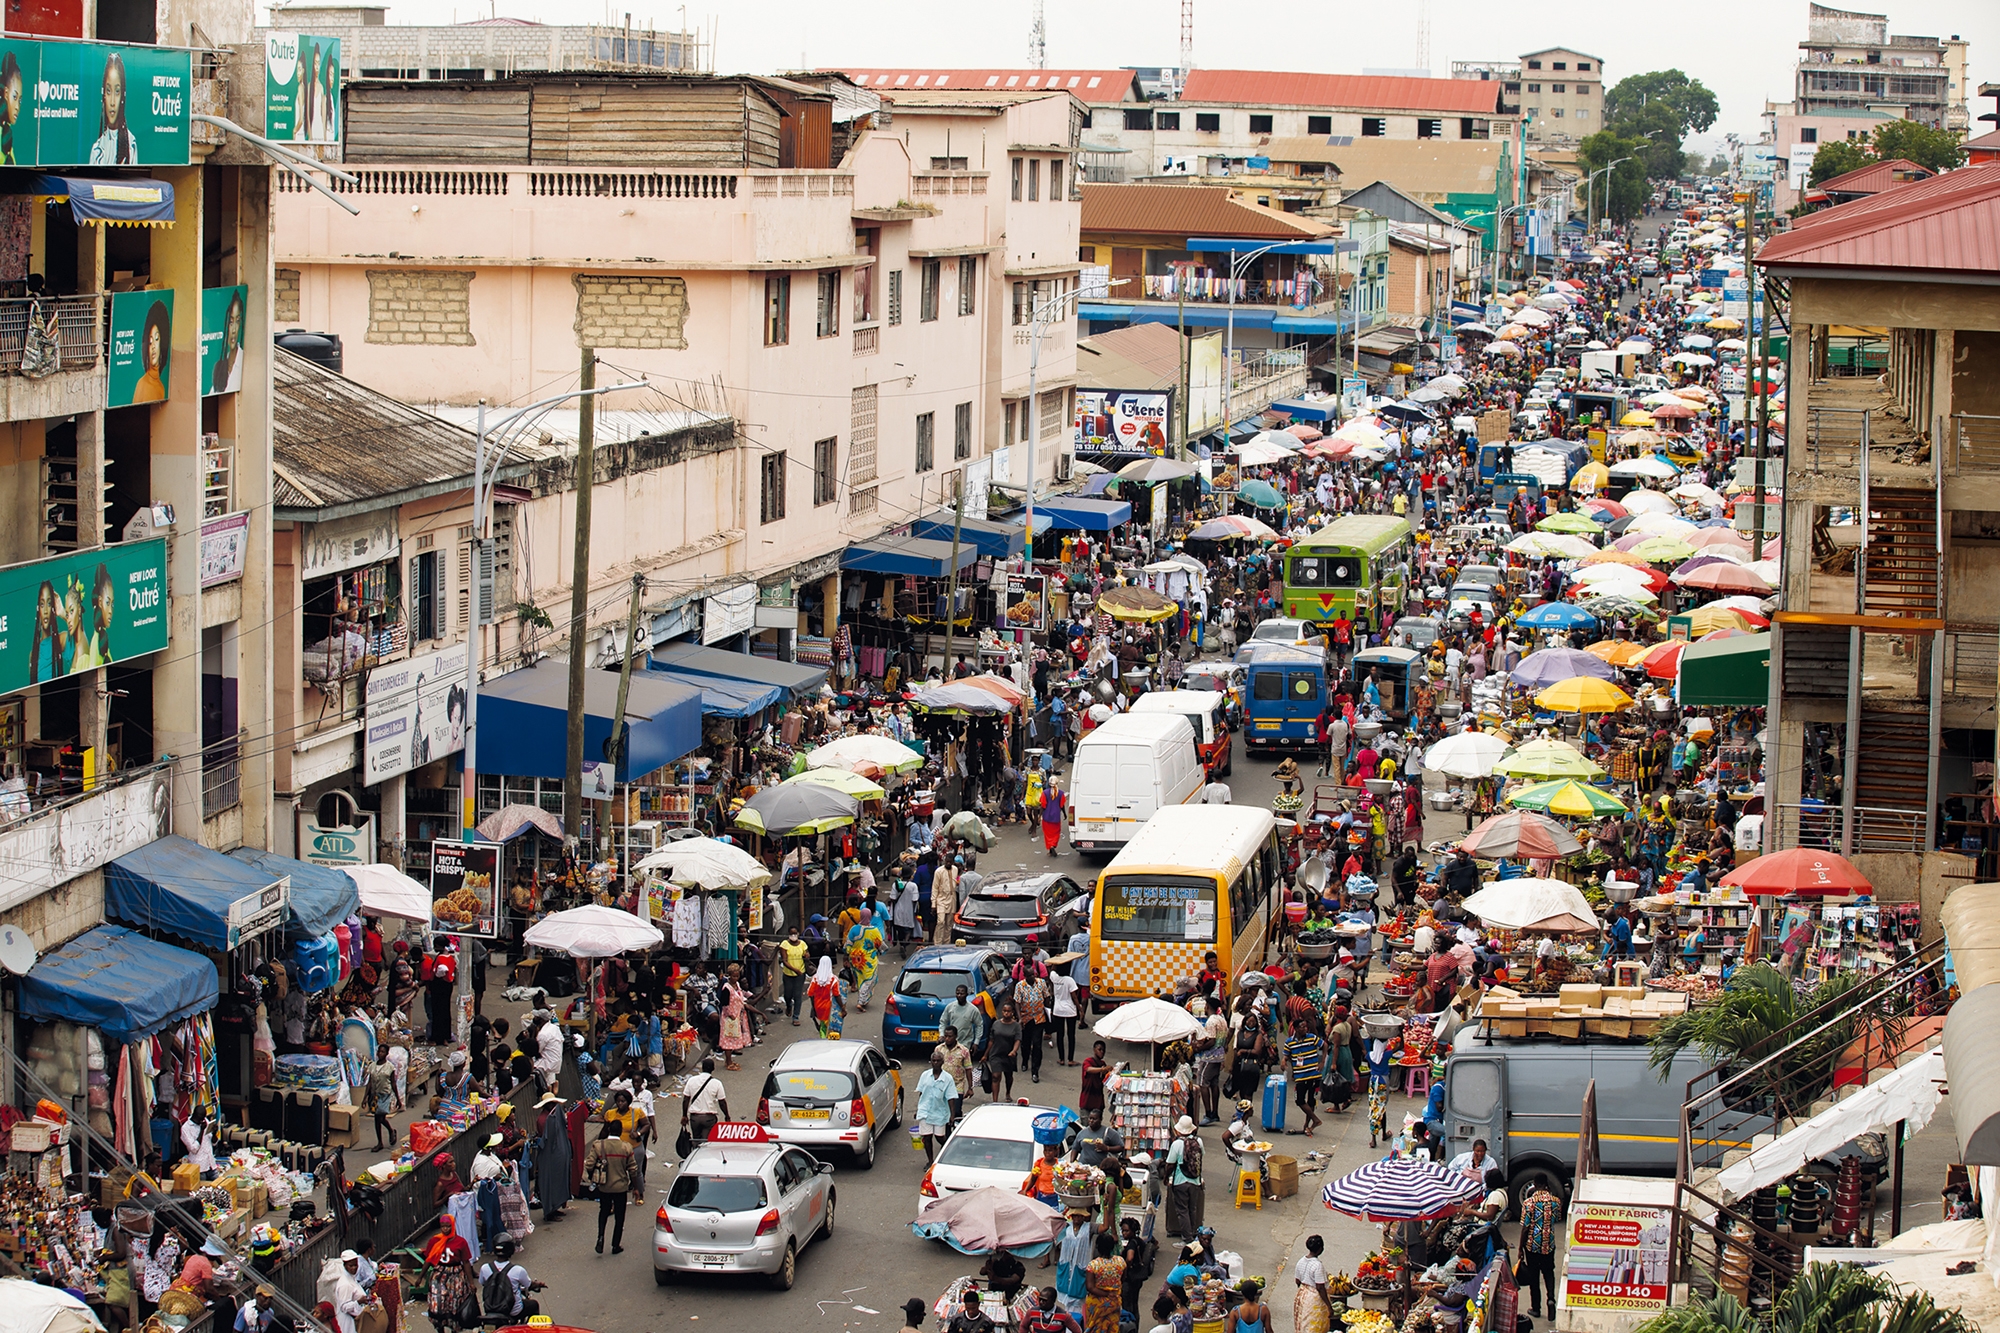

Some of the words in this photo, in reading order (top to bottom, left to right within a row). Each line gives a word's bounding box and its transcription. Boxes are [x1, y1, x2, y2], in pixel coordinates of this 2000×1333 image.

[271, 39, 295, 60] Outré
[153, 76, 166, 88] NEW
[166, 76, 180, 88] LOOK
[34, 84, 37, 100] I
[50, 84, 79, 100] OUTRE
[152, 92, 182, 116] Outré
[34, 108, 50, 118] Braid
[51, 108, 62, 118] and
[62, 108, 78, 118] More!
[115, 340, 135, 355] Outré
[129, 570, 142, 584] NEW
[142, 567, 157, 582] LOOK
[129, 582, 160, 611] Outré
[443, 654, 465, 670] DARLING
[368, 680, 380, 696] SAINT
[19, 824, 46, 857] HAIR
[320, 837, 349, 852] ATL
[439, 856, 456, 865] HOT
[435, 864, 465, 875] CRISPY
[262, 888, 279, 906] JOHN
[1122, 887, 1128, 898] IF
[1130, 887, 1143, 898] ANY
[1144, 887, 1158, 898] MAN
[1160, 888, 1168, 898] BE
[1169, 888, 1176, 898] IN
[1178, 889, 1199, 899] CHRIST
[717, 1124, 758, 1139] YANGO
[1575, 1207, 1617, 1217] AKONIT
[1619, 1209, 1665, 1219] FABRICS
[1582, 1284, 1622, 1295] SHOP
[1625, 1286, 1651, 1297] 140
[1571, 1296, 1592, 1305] TEL:
[1594, 1297, 1660, 1308] 0249703900
